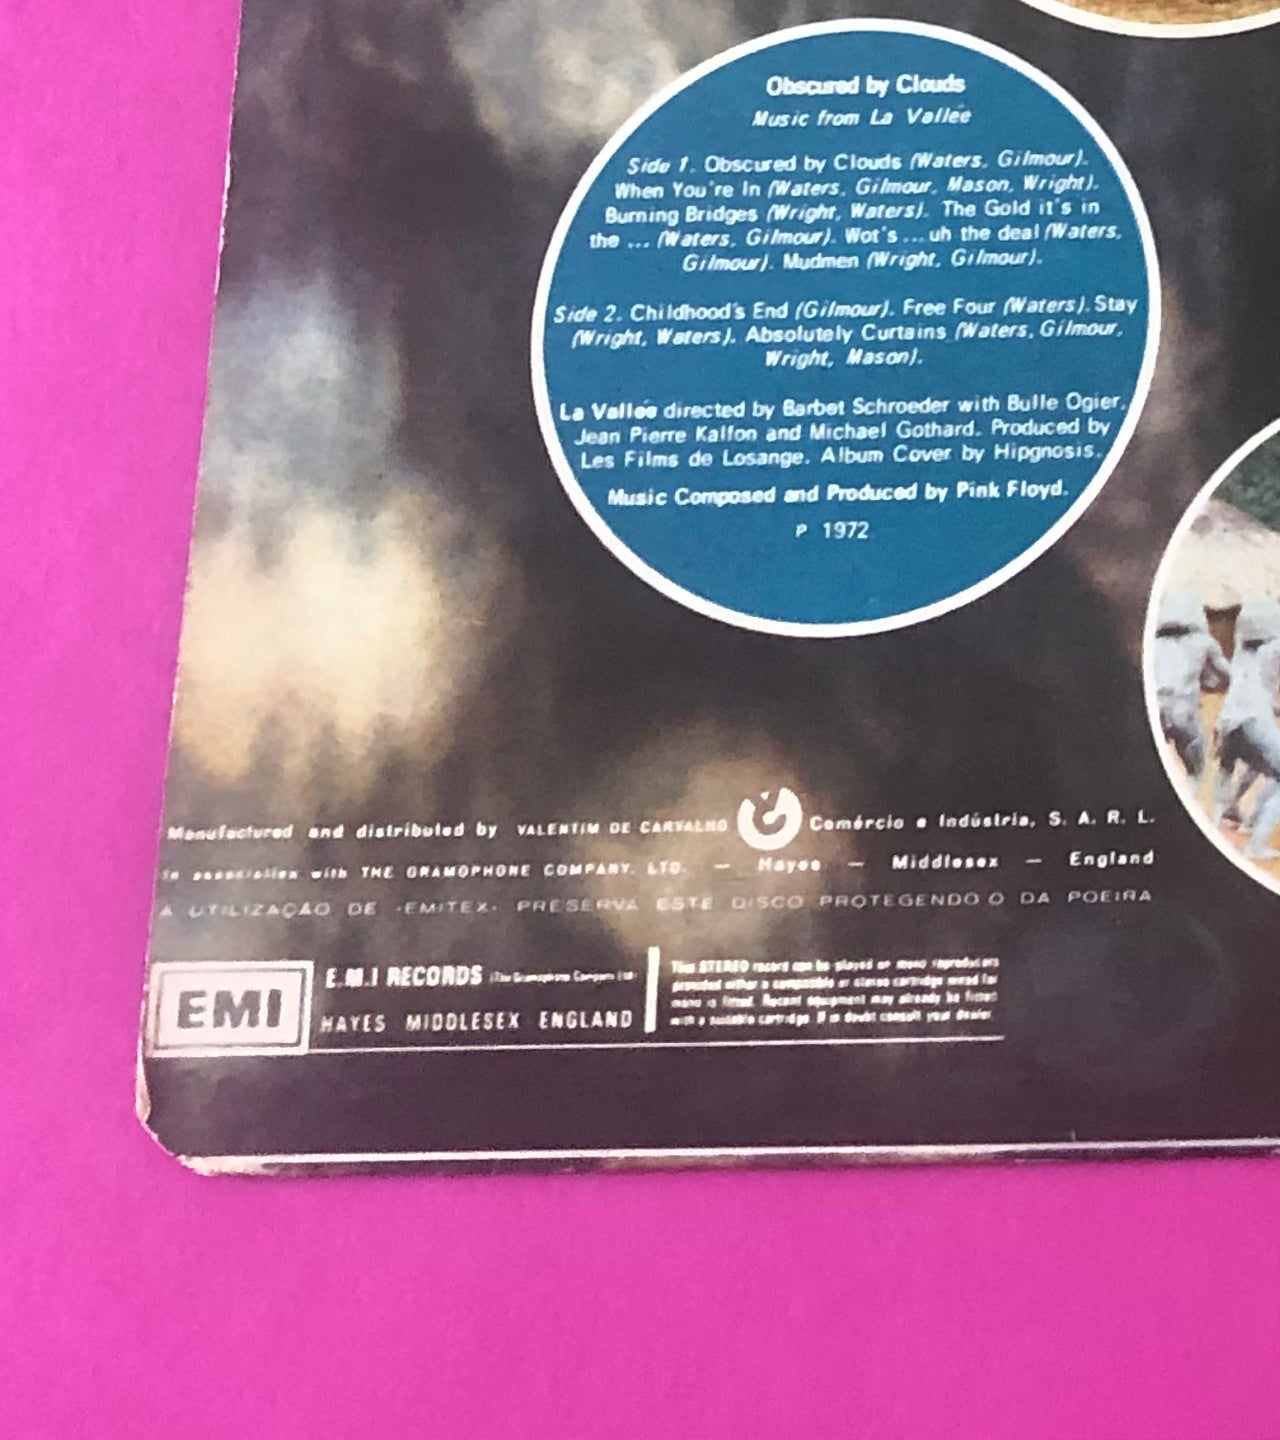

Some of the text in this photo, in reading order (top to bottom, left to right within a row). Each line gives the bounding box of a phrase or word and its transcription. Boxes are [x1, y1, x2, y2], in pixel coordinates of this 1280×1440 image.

[765, 73, 967, 99] Obscured by Clouds
[752, 110, 810, 128] Music
[816, 109, 860, 127] from
[869, 108, 894, 126] La
[627, 157, 671, 176] Side
[704, 155, 797, 174] Obscured
[803, 155, 827, 175] by
[833, 153, 902, 171] Clouds
[614, 182, 665, 200] When
[742, 180, 761, 198] In
[605, 206, 680, 228] Burning
[685, 205, 759, 227] Bridges
[942, 199, 977, 219] The
[984, 198, 1031, 217] Gold
[1081, 201, 1100, 215] in
[589, 232, 620, 250] the
[929, 225, 952, 244] uh
[960, 225, 992, 243] the
[997, 224, 1040, 242] deal
[783, 252, 860, 271] Mudmen
[553, 305, 598, 325] Side
[752, 301, 789, 321] End
[903, 298, 947, 318] Free
[952, 297, 997, 316] Four
[1094, 295, 1138, 315] Stay
[745, 324, 854, 345] Absolutely
[861, 324, 947, 342] Curtains
[559, 402, 585, 422] La
[663, 400, 746, 420] directed
[751, 400, 776, 422] by
[782, 398, 845, 418] Barbet
[852, 397, 950, 416] Schroeder
[957, 395, 1000, 413] with
[1007, 393, 1059, 413] Bulle
[574, 428, 621, 447] Jean
[629, 426, 687, 445] Pierre
[695, 425, 758, 443] Kalfon
[765, 424, 802, 443] and
[809, 421, 887, 441] Michael
[991, 418, 1080, 437] Produced
[1087, 416, 1111, 437] by
[580, 452, 615, 470] Les
[624, 450, 679, 469] Films
[688, 450, 714, 468] de
[820, 446, 885, 465] Album
[892, 444, 952, 464] Cover
[961, 443, 986, 464] by
[607, 479, 1068, 509] Music Composed and Produced by Pink Floyd.
[823, 521, 870, 540] 1972
[386, 965, 483, 988] RECORDS
[177, 989, 283, 1029] EMI
[320, 1010, 633, 1034] HAYES MIDDLESEX ENGLAND
